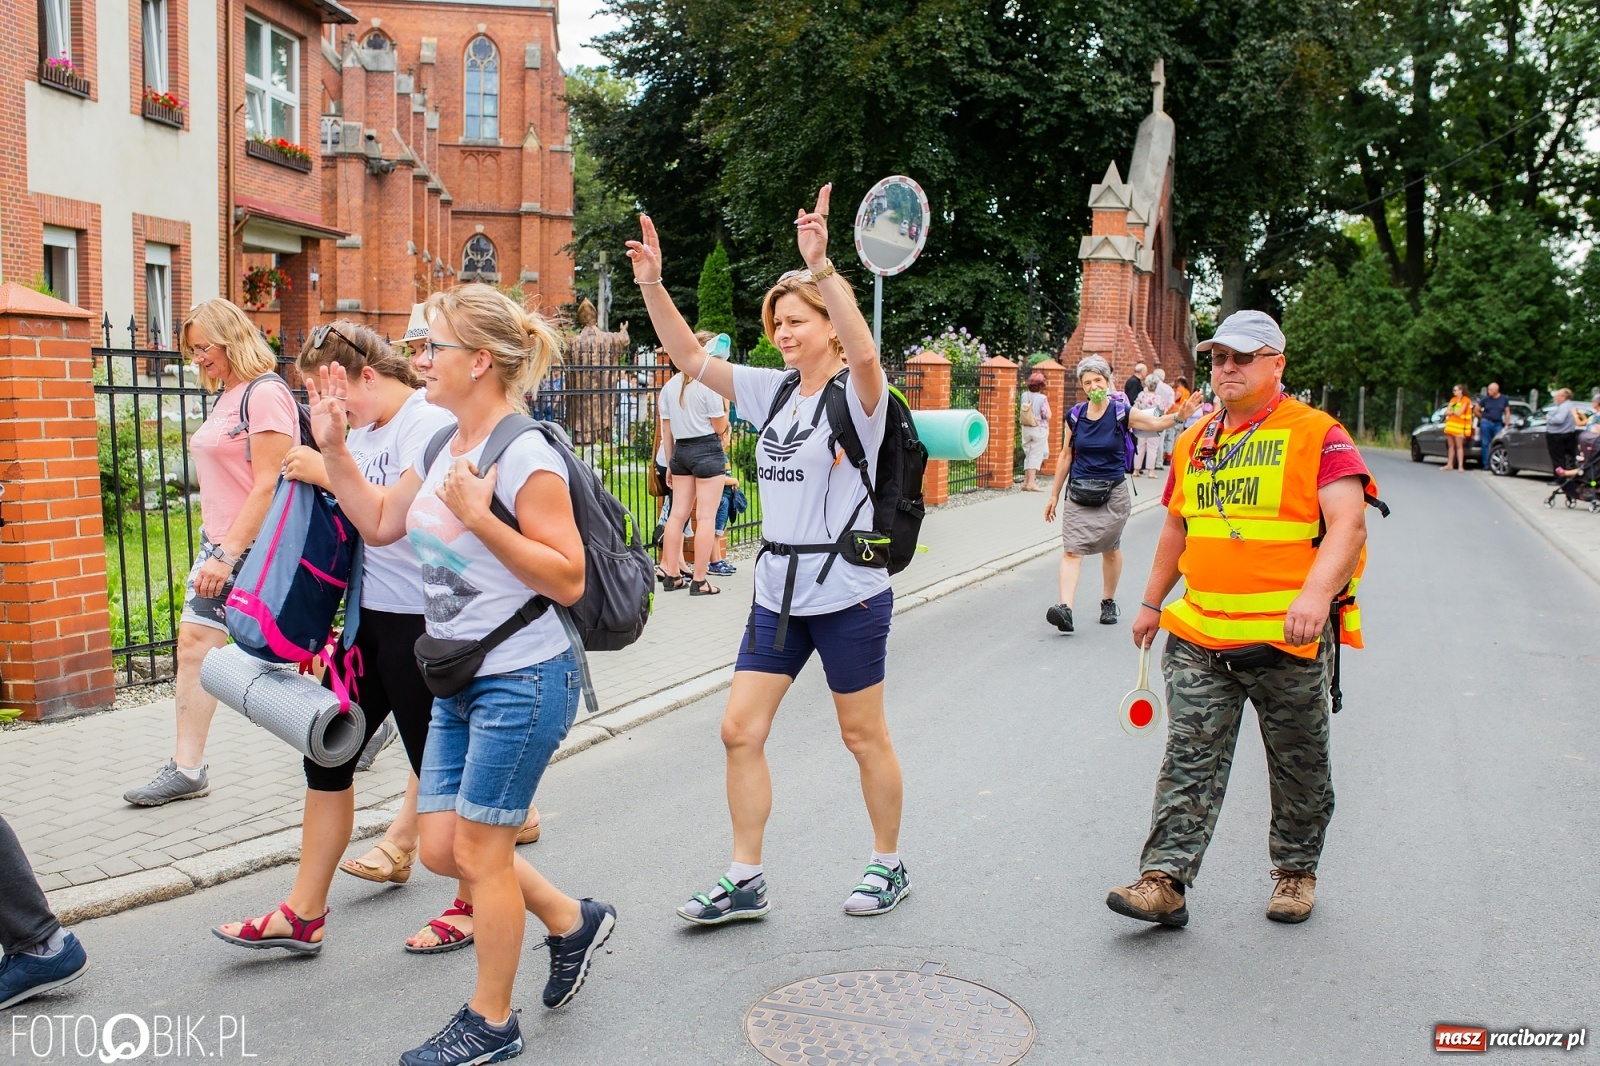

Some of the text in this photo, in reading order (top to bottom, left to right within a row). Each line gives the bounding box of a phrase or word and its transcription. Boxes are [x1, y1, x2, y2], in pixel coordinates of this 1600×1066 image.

[758, 465, 805, 482] adidas
[1187, 440, 1284, 475] OWANIE
[1197, 477, 1259, 509] RUCHEM
